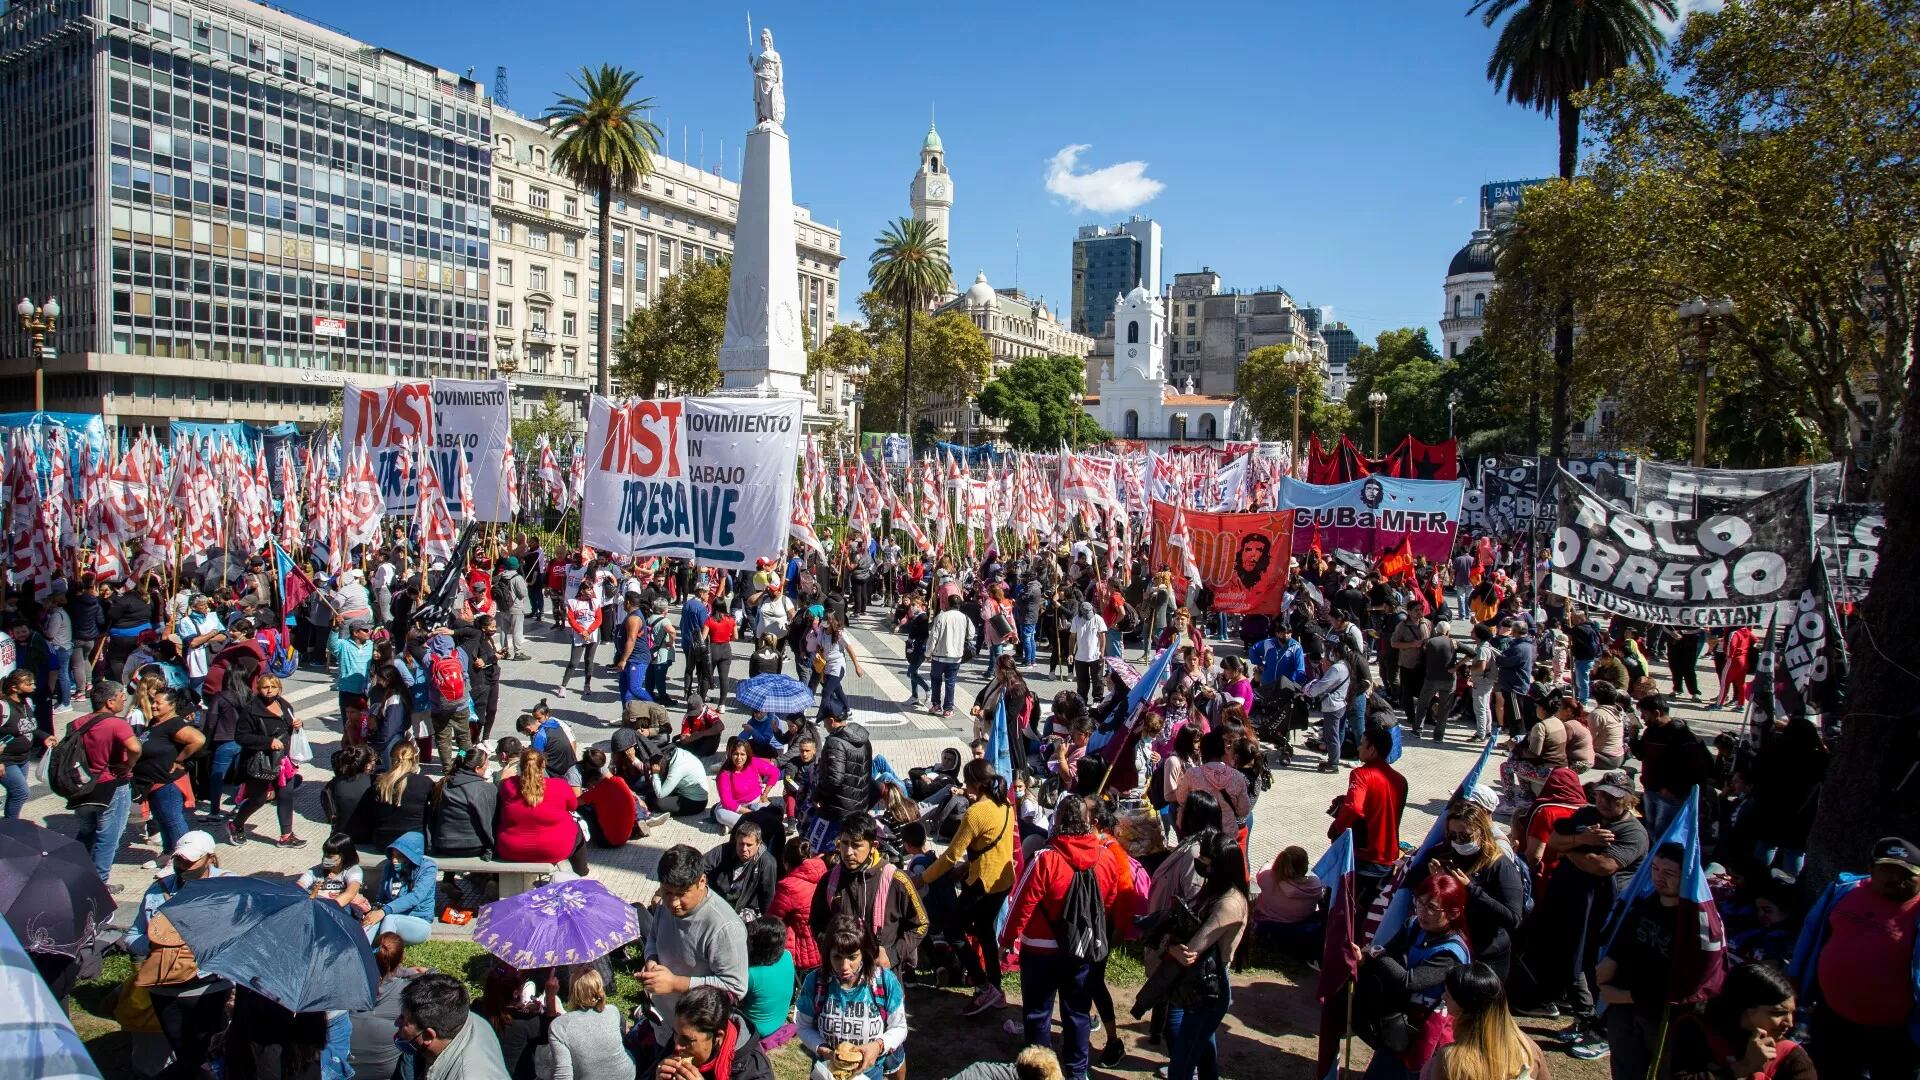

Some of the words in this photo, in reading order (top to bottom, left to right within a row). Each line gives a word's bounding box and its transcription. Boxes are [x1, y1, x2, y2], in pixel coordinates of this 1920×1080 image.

[1494, 186, 1524, 198] BAN
[431, 390, 505, 406] OVIMIENTO
[436, 433, 479, 449] ABAJO
[689, 466, 745, 485] RABAJO
[691, 485, 740, 547] IVE
[1381, 509, 1448, 533] MTR
[1575, 495, 1752, 555] POLO
[1552, 527, 1787, 601] OBRERO
